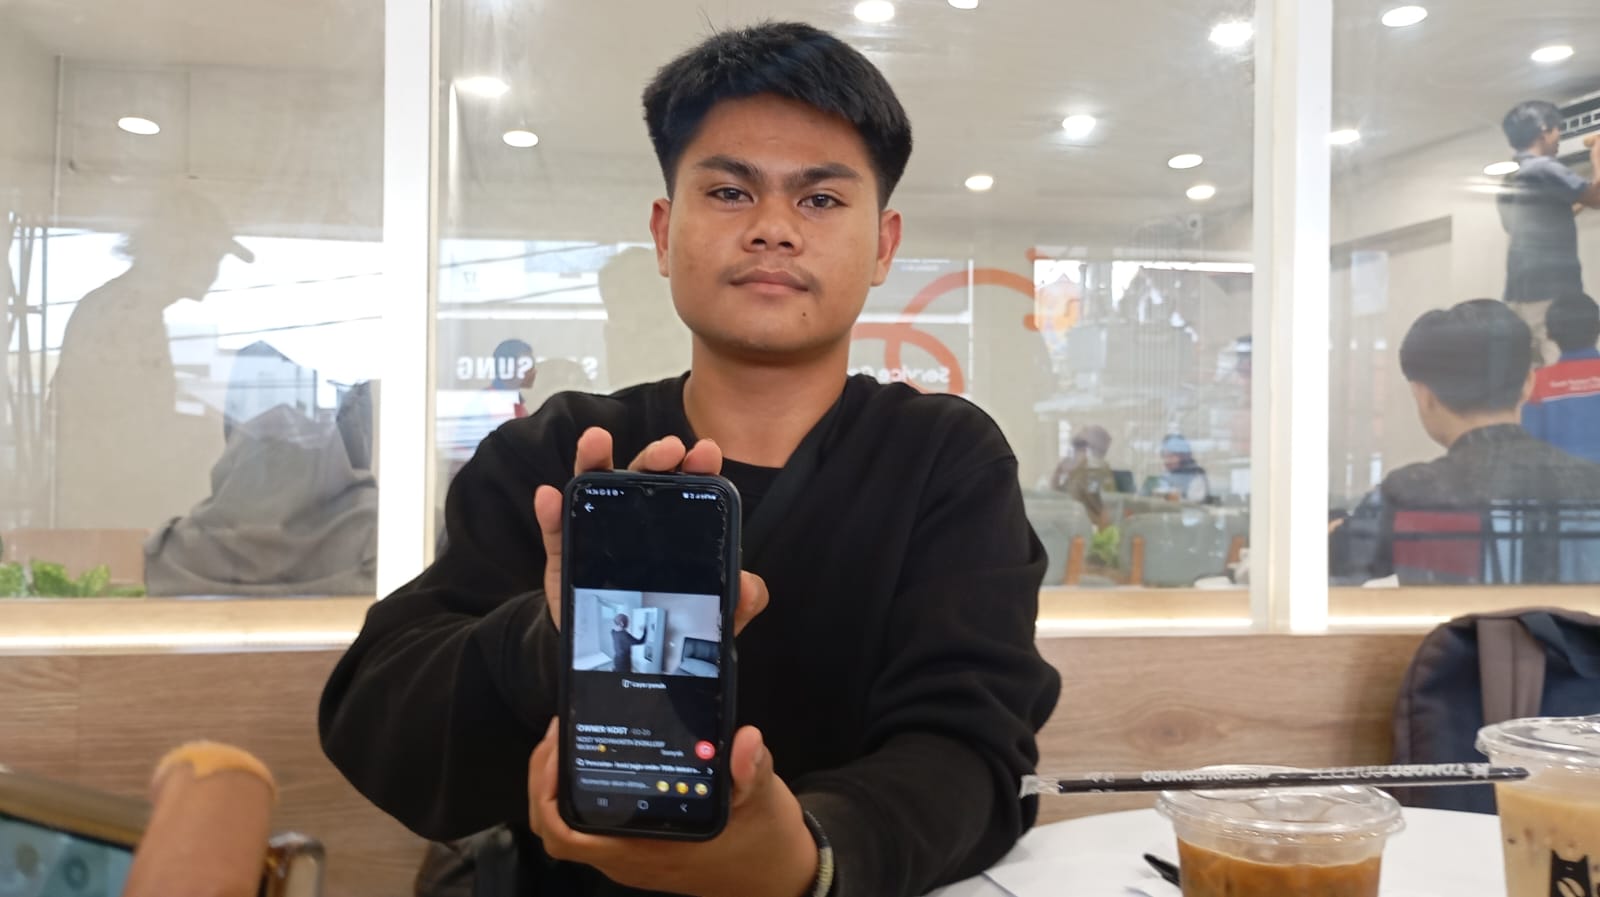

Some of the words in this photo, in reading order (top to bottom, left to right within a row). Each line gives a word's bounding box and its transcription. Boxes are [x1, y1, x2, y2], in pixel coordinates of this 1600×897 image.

[606, 725, 628, 735] KOST
[1309, 766, 1390, 780] COFFEE
[1390, 763, 1465, 778] TOMORO
